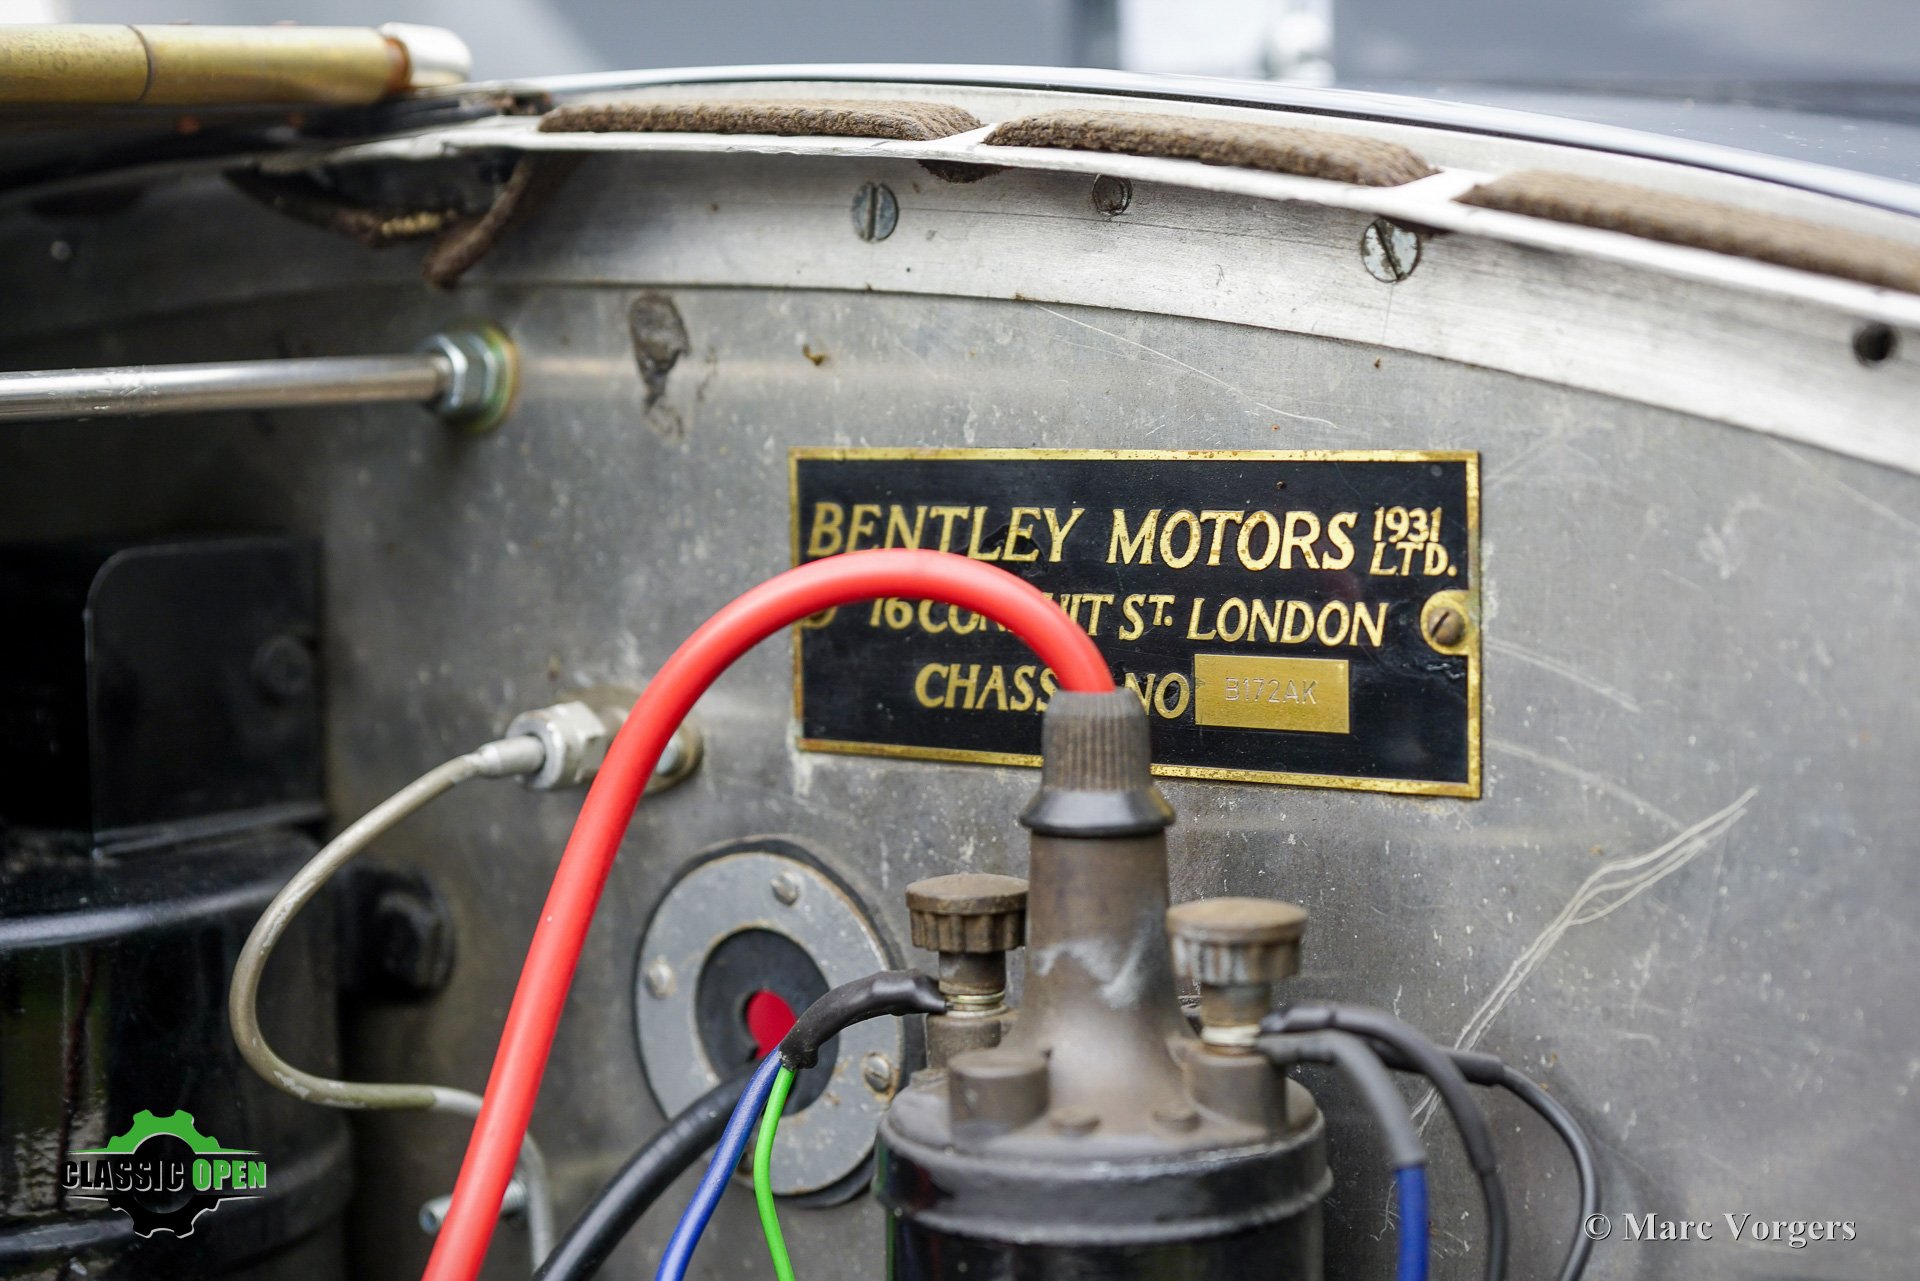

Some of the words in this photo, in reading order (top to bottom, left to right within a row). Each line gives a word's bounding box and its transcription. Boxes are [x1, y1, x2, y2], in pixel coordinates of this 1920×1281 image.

[807, 502, 1085, 563] BENTLEY
[1105, 508, 1359, 571] MOTORS
[1373, 506, 1443, 543] 1931
[1369, 541, 1457, 577] LTD.
[1119, 593, 1176, 641] ST.
[1186, 597, 1390, 648] LONDON
[914, 662, 1059, 712] CHASS
[1225, 677, 1318, 705] B172AK
